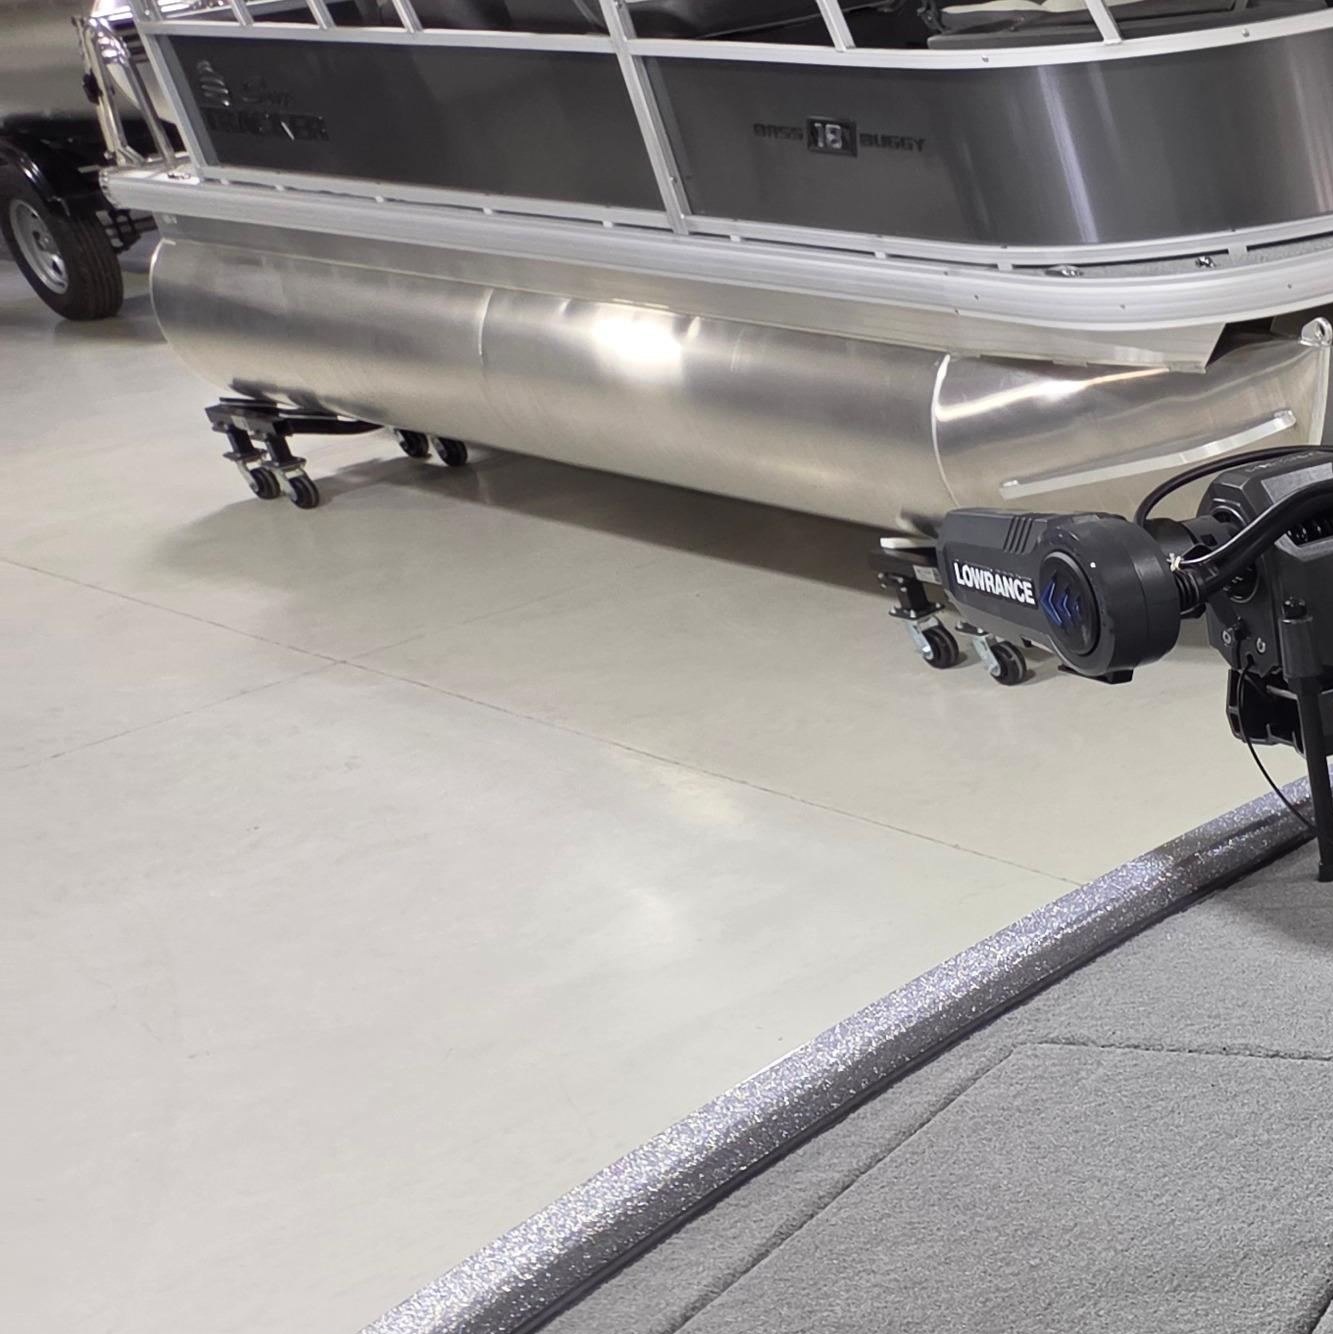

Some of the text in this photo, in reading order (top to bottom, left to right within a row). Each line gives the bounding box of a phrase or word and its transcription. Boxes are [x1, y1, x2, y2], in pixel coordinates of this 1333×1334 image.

[813, 122, 843, 149] 18
[859, 132, 926, 152] BUGGY
[953, 561, 1036, 605] LOWRANCE
